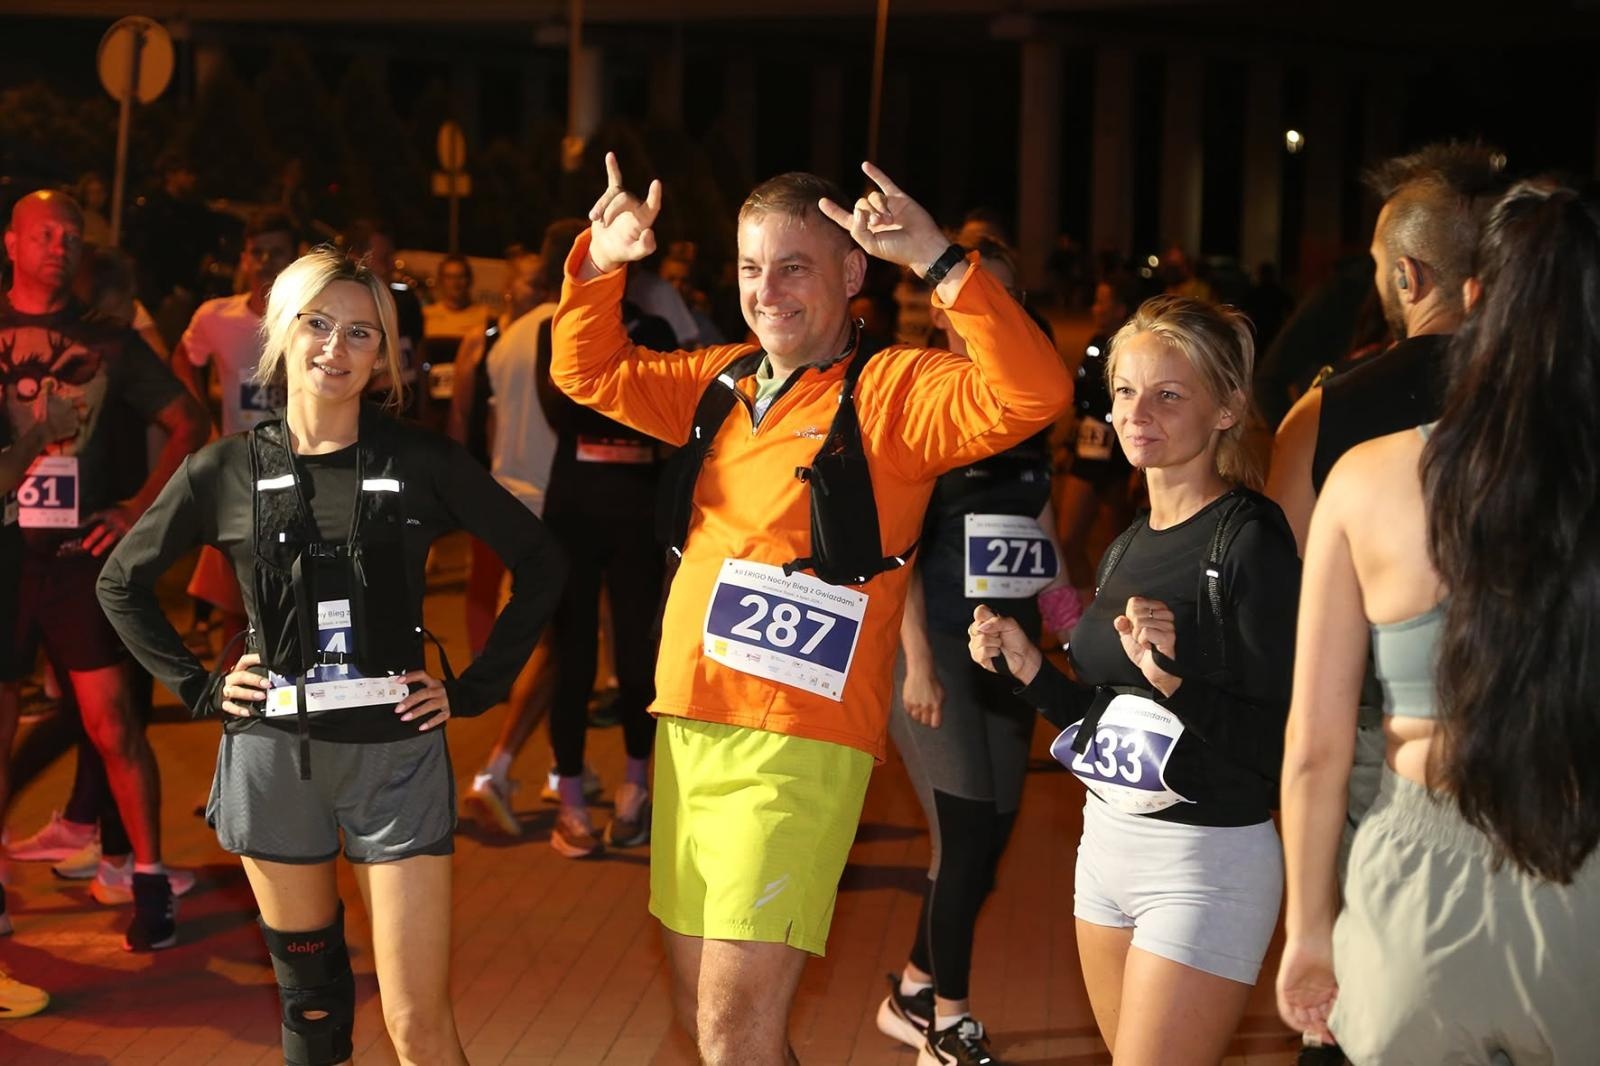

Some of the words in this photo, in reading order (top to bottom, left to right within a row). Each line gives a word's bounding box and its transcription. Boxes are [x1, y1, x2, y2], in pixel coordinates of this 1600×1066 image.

[17, 476, 61, 506] 61
[986, 539, 1045, 575] 271
[767, 575, 791, 588] Nocny
[792, 582, 809, 594] Bieg
[815, 589, 855, 607] Gwiazdami
[730, 594, 837, 655] 287
